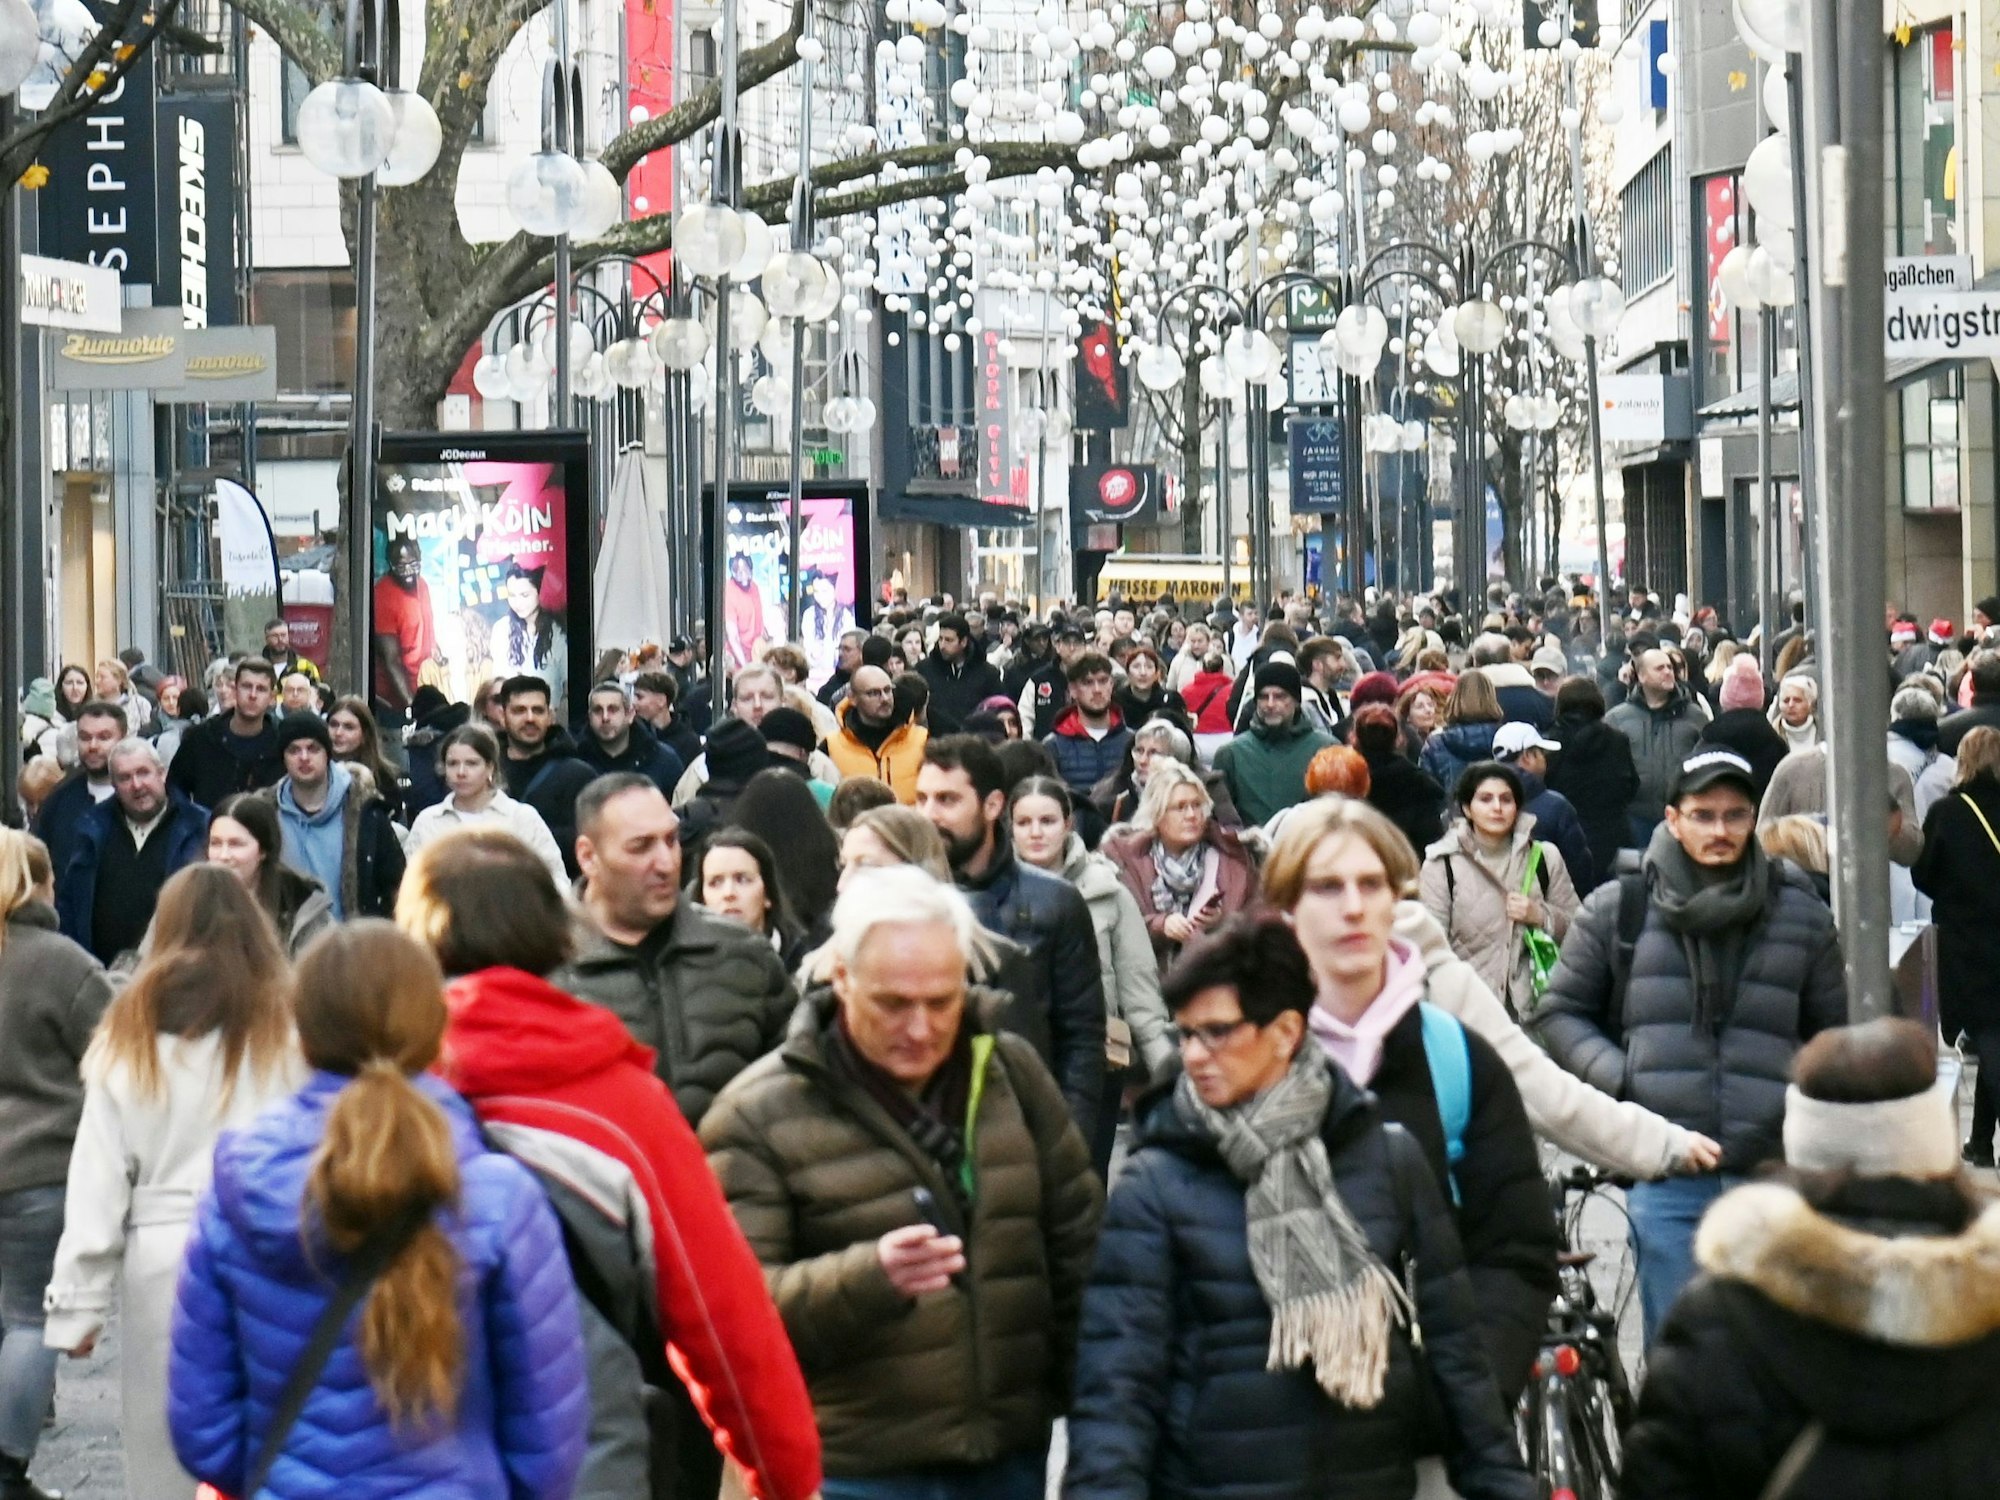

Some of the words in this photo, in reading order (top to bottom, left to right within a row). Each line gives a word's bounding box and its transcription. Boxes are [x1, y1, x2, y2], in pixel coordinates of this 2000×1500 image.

[178, 114, 208, 330] SKECHER
[440, 448, 487, 460] JCDecaux
[1165, 581, 1242, 597] MARONN
